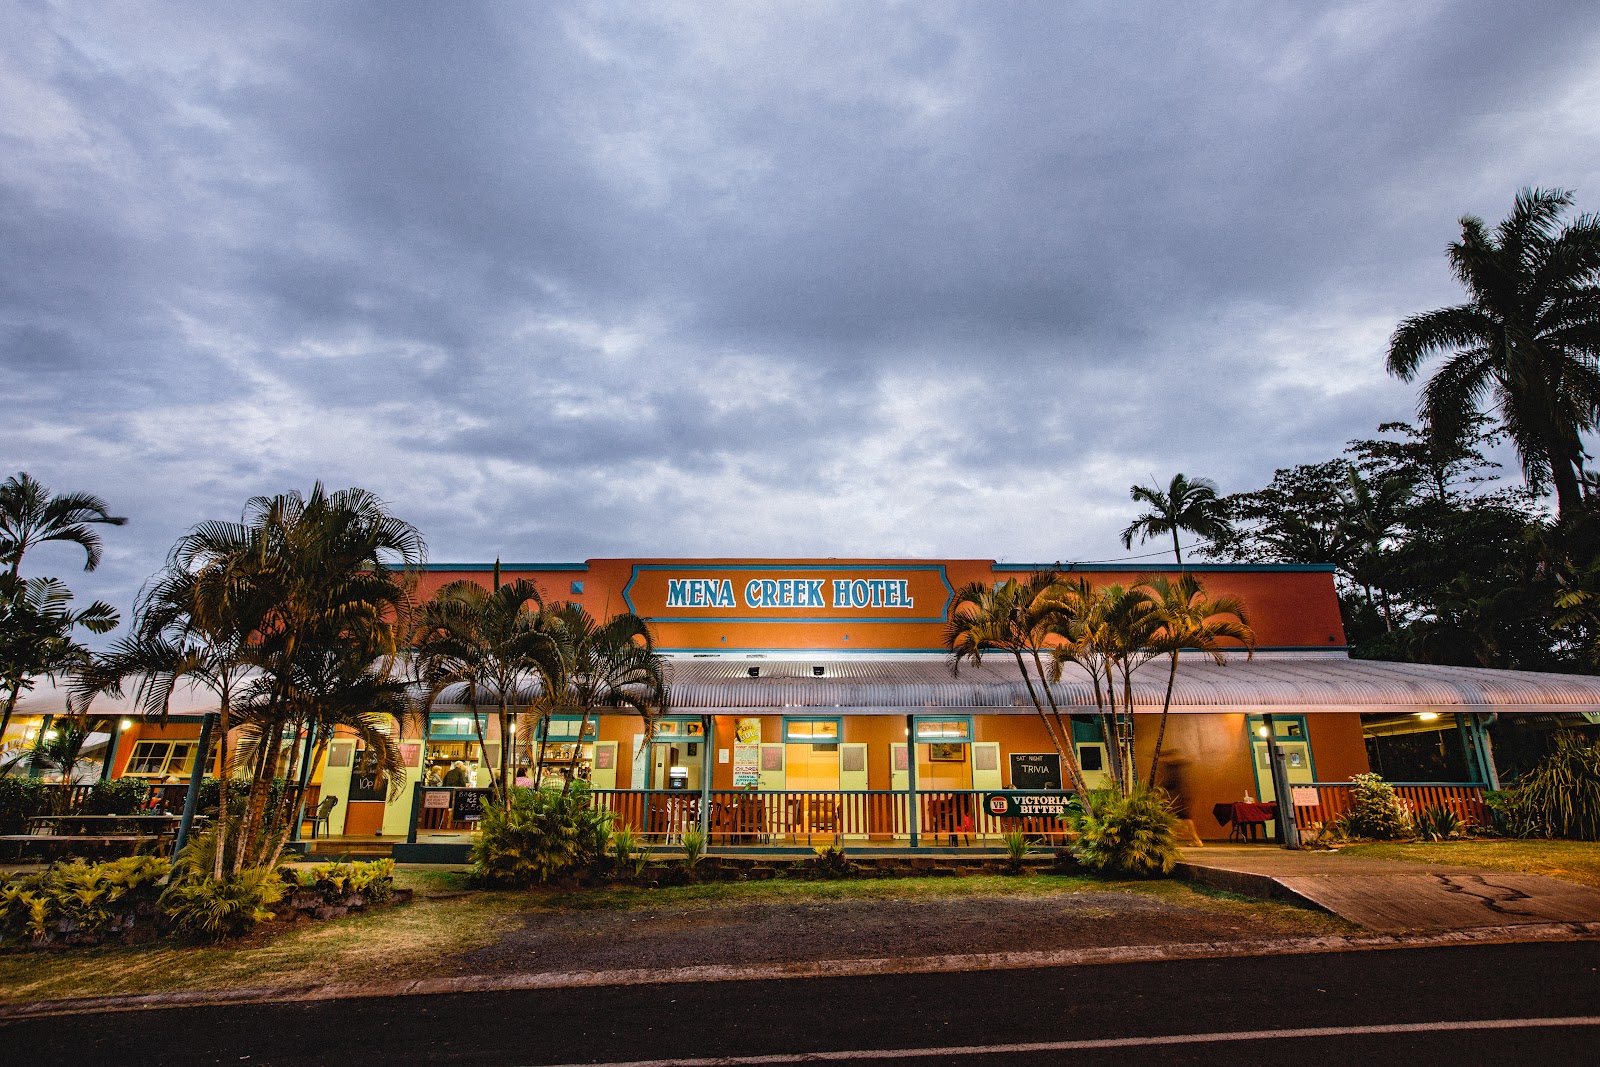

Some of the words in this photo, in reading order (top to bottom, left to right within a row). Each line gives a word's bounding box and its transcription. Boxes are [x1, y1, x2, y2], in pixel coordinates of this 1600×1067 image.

[666, 579, 736, 608] MENA
[744, 579, 826, 608] CREEK
[832, 579, 914, 609] HOTEL
[1021, 765, 1049, 773] TRIVIA
[1012, 796, 1070, 805] VICTORIA
[993, 801, 1005, 809] VB
[1020, 805, 1064, 813] BITTER
